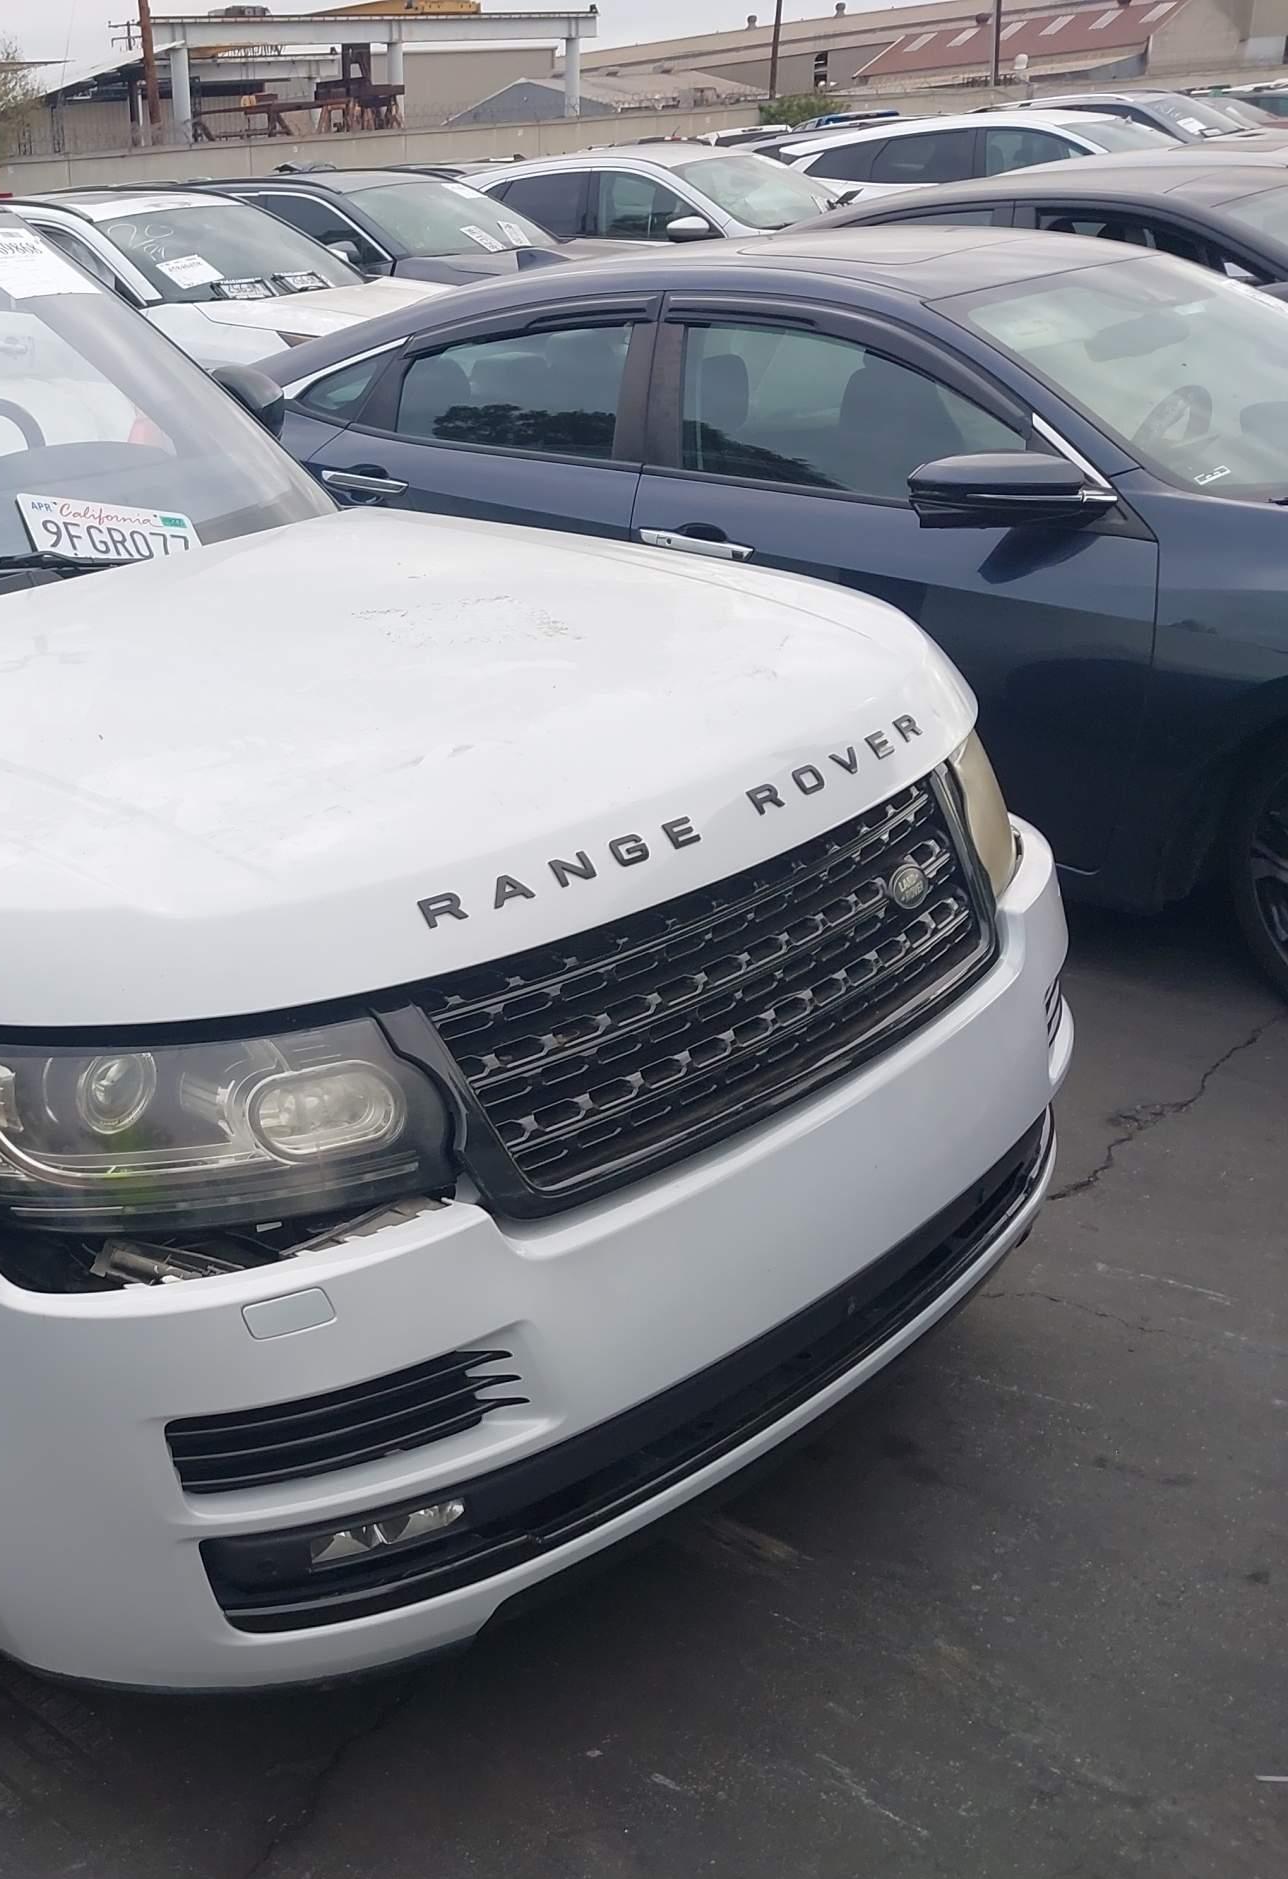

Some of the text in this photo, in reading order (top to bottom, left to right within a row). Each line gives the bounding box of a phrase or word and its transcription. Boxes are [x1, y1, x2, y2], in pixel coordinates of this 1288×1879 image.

[31, 501, 53, 513] APR
[59, 503, 160, 527] California
[42, 519, 190, 559] 9FGR077
[417, 714, 924, 928] RANGE ROVER
